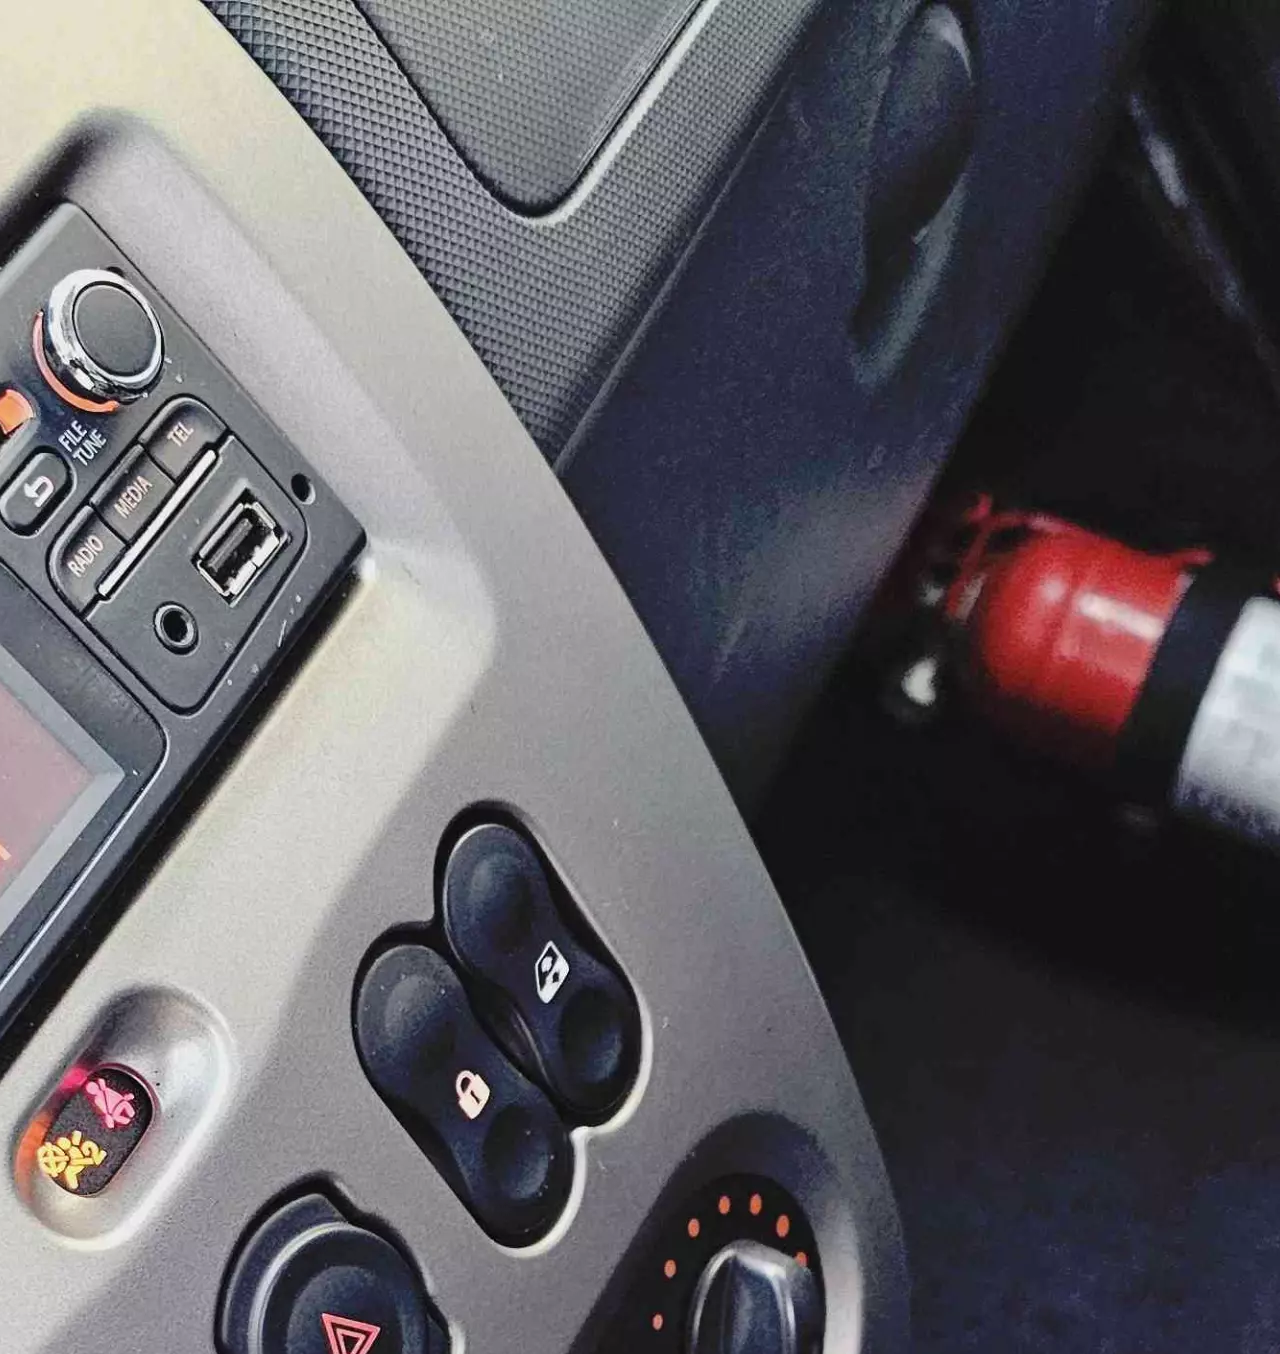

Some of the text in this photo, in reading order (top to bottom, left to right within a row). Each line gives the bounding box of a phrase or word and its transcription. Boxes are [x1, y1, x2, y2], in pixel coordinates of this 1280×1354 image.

[58, 420, 88, 452] FILE
[72, 429, 107, 466] TUNE
[166, 421, 194, 447] TEL
[113, 475, 153, 519] MEDIA
[67, 535, 104, 578] RADIO
